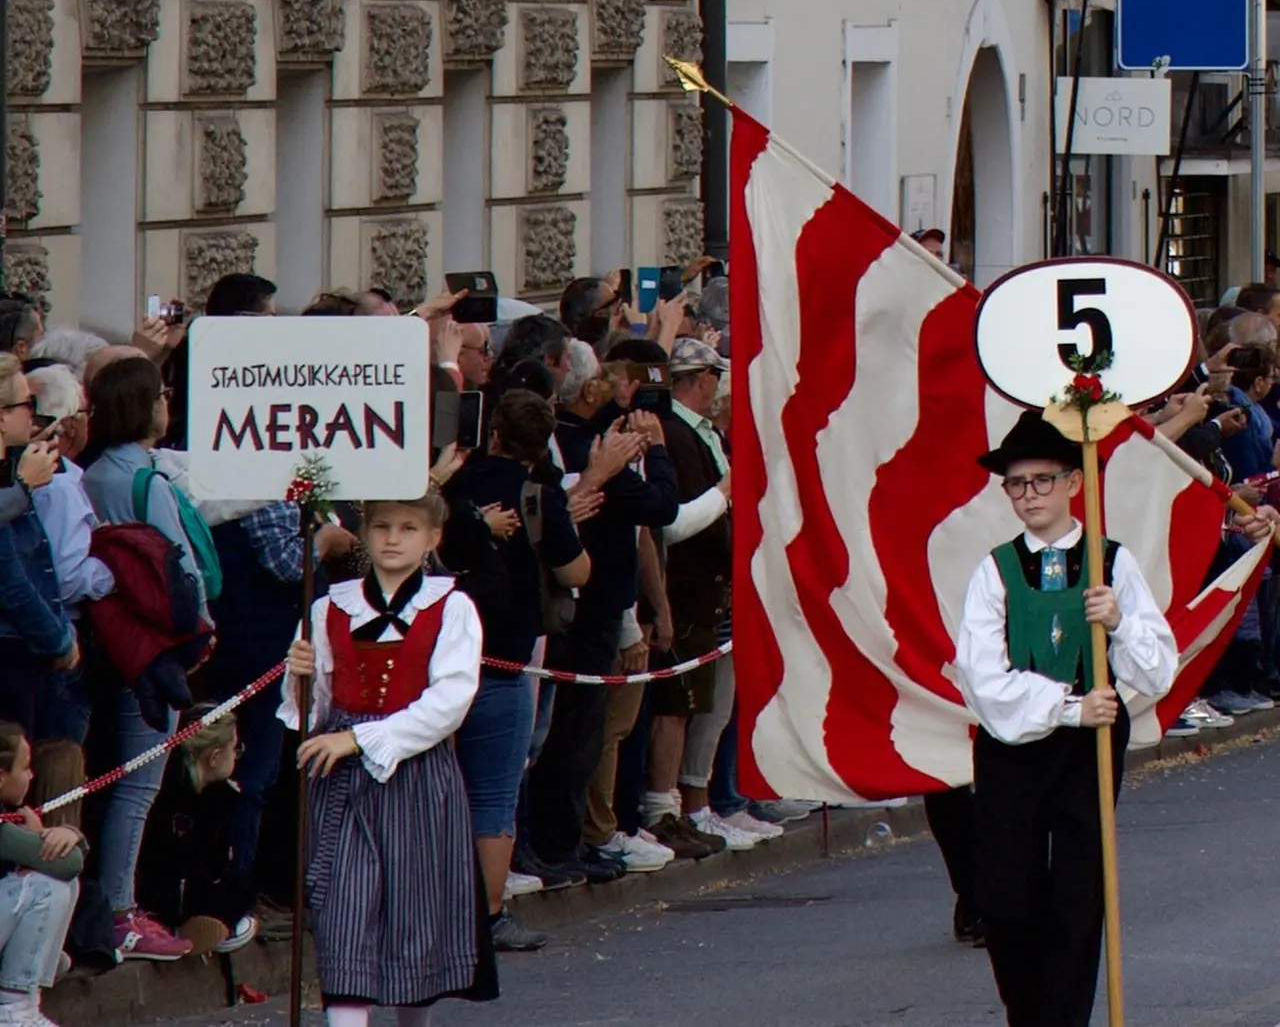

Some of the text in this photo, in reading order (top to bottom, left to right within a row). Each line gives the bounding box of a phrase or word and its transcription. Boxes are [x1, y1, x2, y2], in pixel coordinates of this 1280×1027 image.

[1075, 106, 1154, 128] NORD
[1057, 278, 1113, 373] 5
[211, 363, 405, 389] STADTMUSIKKAPELLE
[212, 401, 405, 452] MERAN
